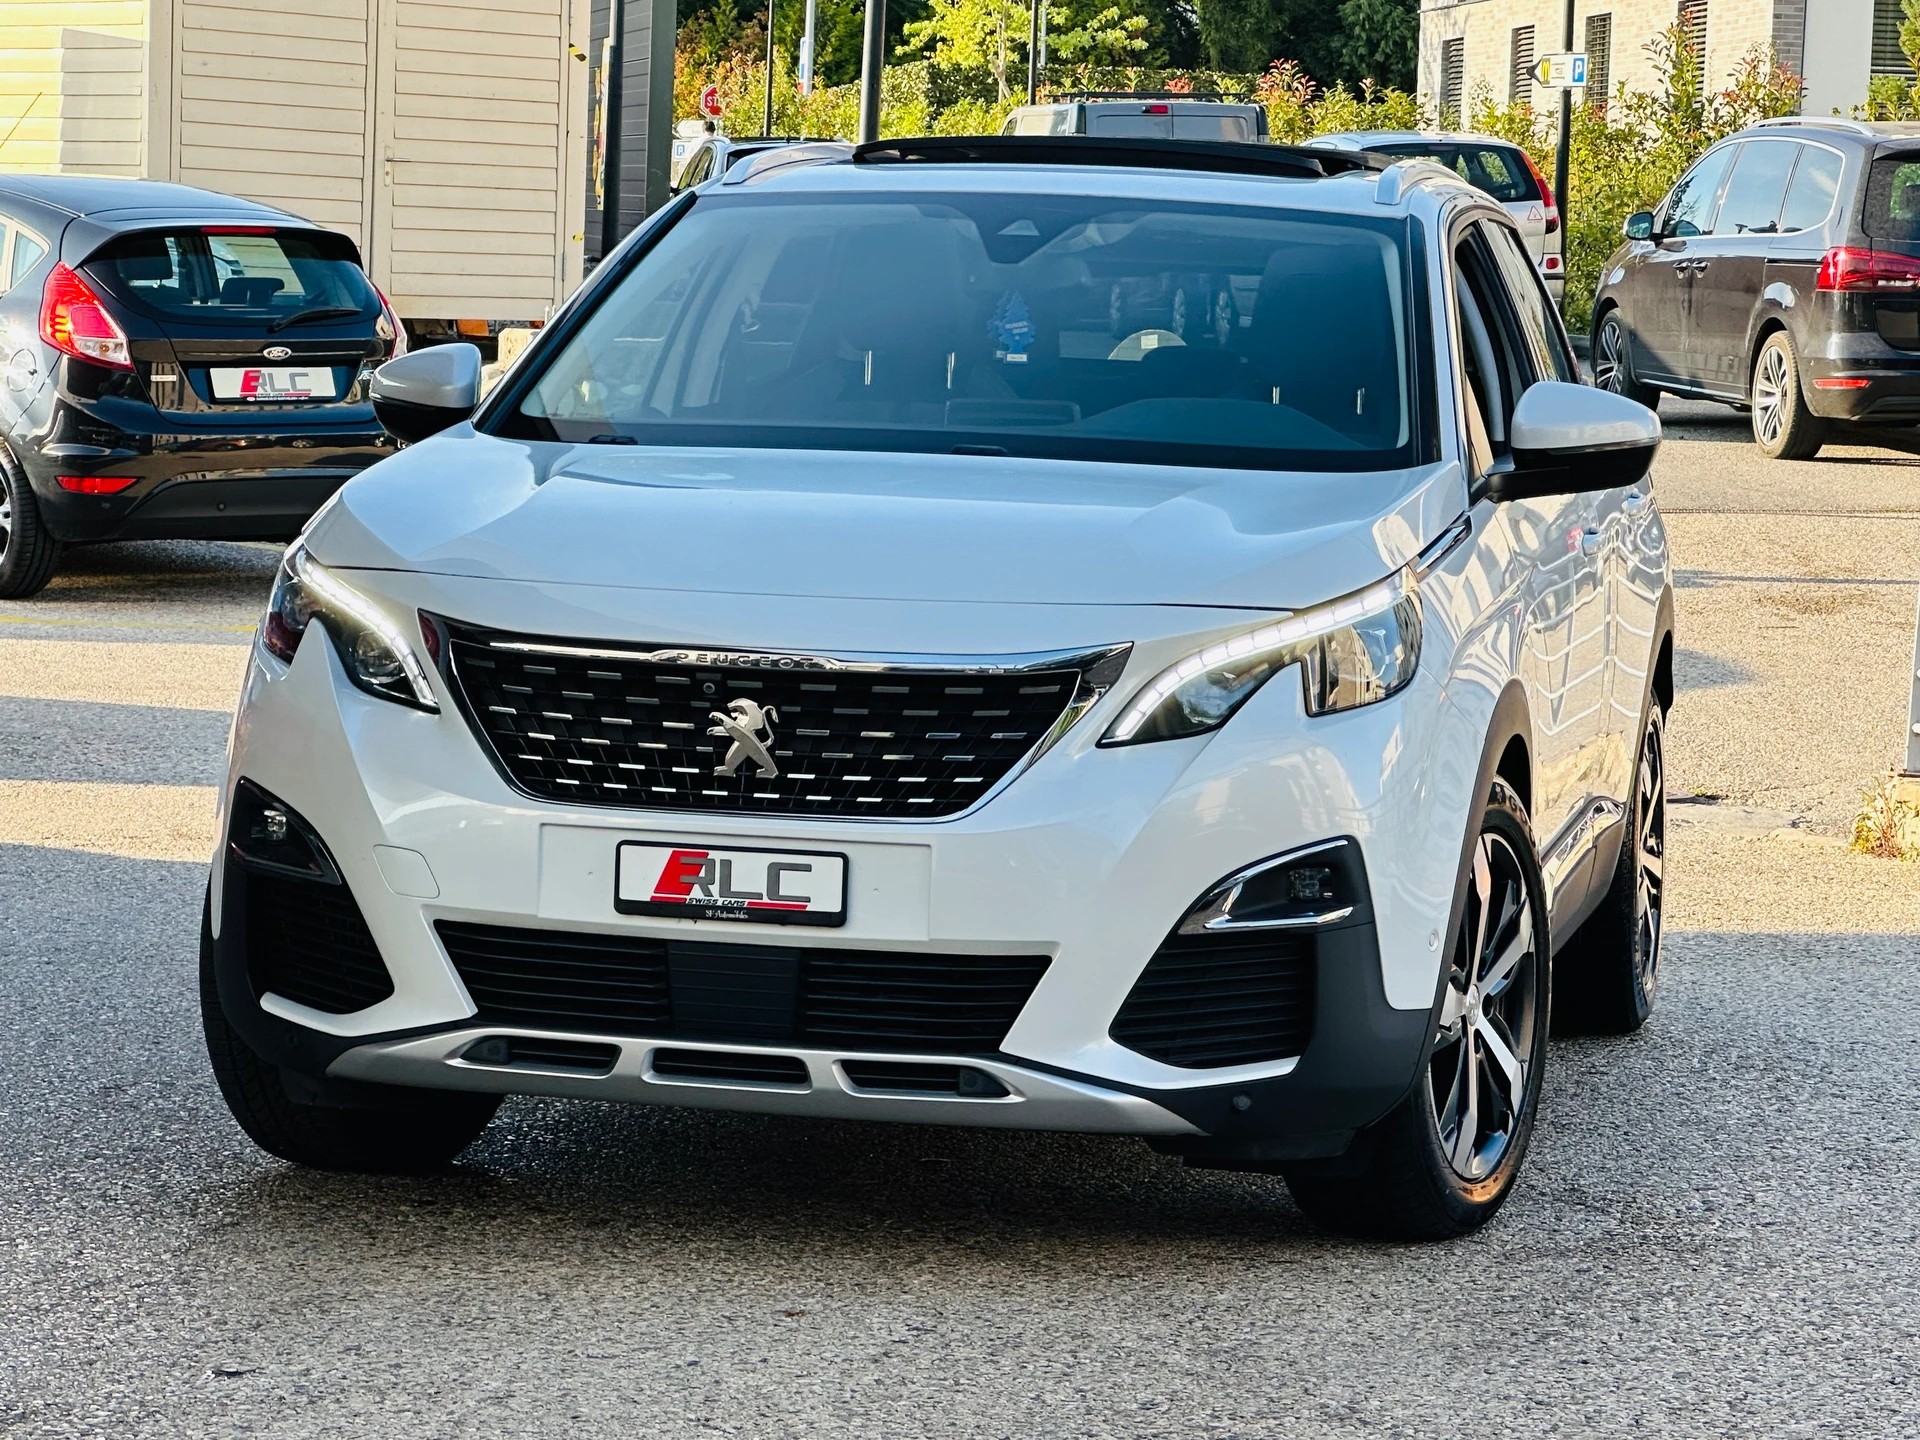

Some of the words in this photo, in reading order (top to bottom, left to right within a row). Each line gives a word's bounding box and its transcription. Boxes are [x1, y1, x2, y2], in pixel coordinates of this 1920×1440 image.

[1574, 60, 1583, 80] P
[676, 652, 814, 670] PEUGEOT
[687, 897, 719, 905] SWISS
[721, 899, 746, 907] CARS
